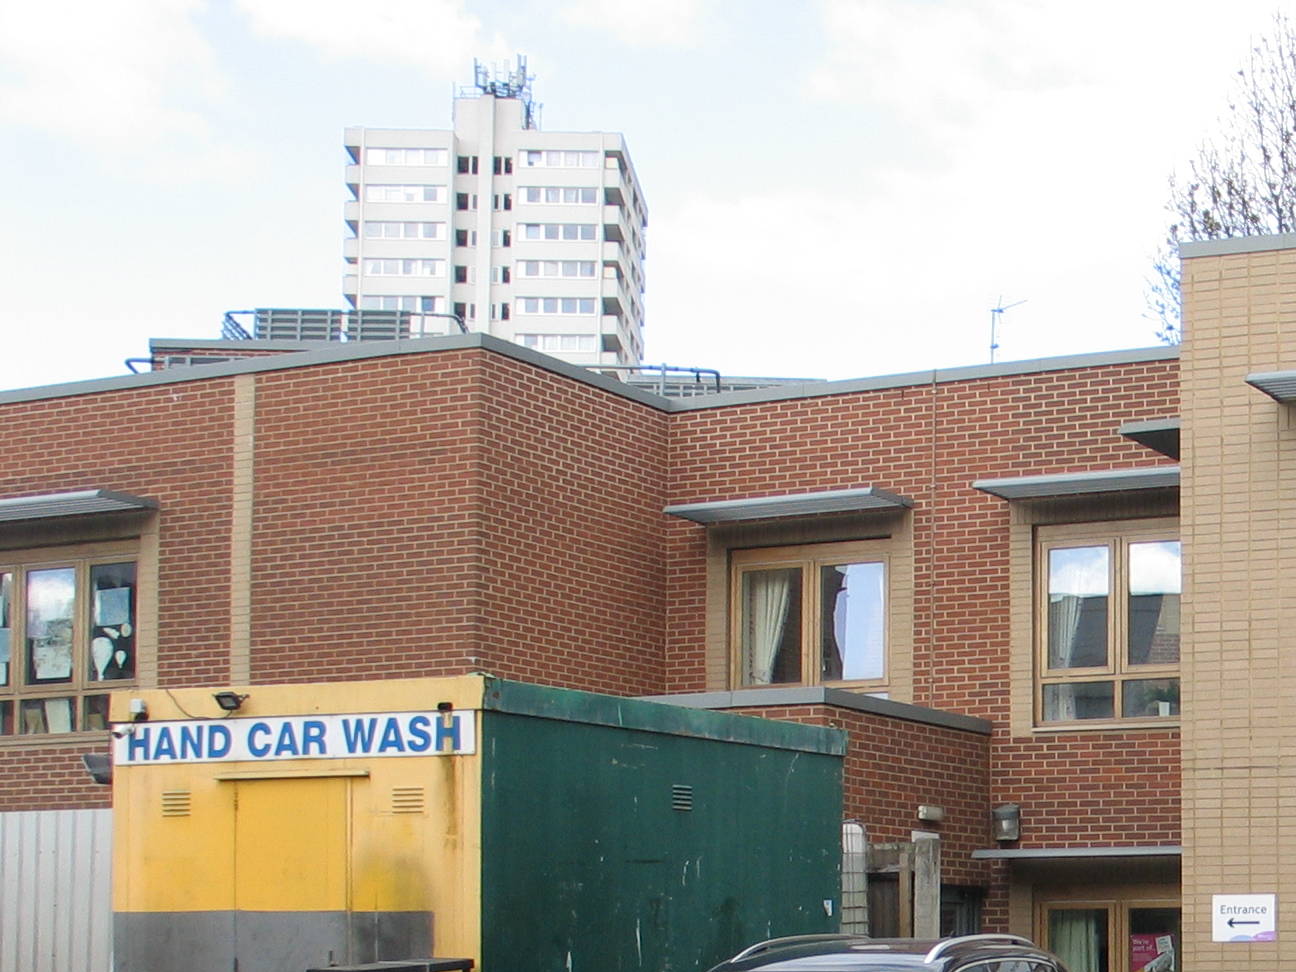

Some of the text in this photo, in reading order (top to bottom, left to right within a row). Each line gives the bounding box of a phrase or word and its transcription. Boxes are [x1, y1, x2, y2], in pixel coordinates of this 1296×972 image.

[127, 715, 462, 761] HAND CAR WASH
[1220, 904, 1268, 915] Entrance
